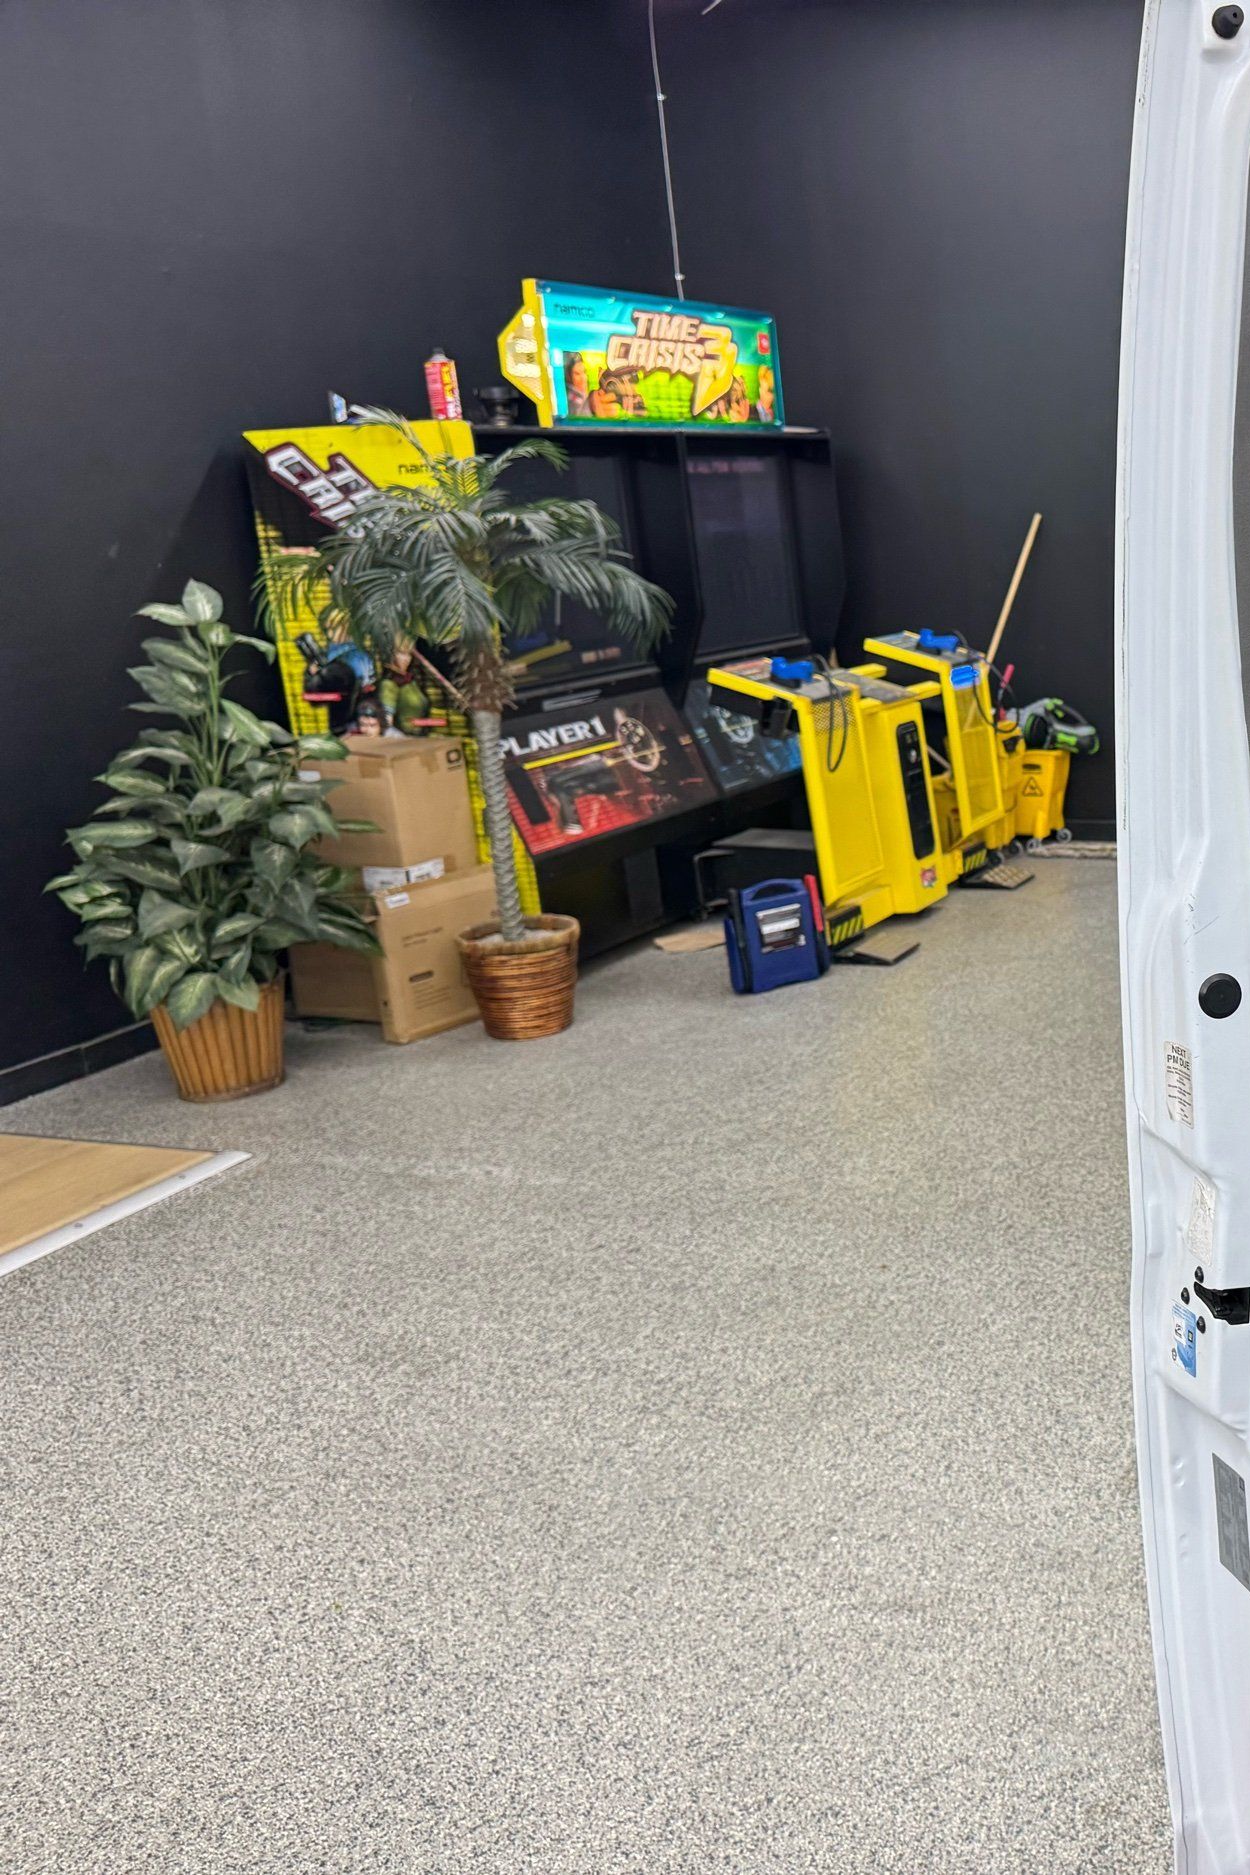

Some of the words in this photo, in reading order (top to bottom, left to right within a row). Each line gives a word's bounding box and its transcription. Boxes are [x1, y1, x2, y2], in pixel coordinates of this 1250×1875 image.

[632, 311, 701, 342] TIME
[607, 335, 704, 374] CRISIS
[692, 323, 738, 416] 3
[498, 720, 594, 760] PLAYER
[590, 715, 607, 737] 1
[1171, 1045, 1186, 1058] NEXT
